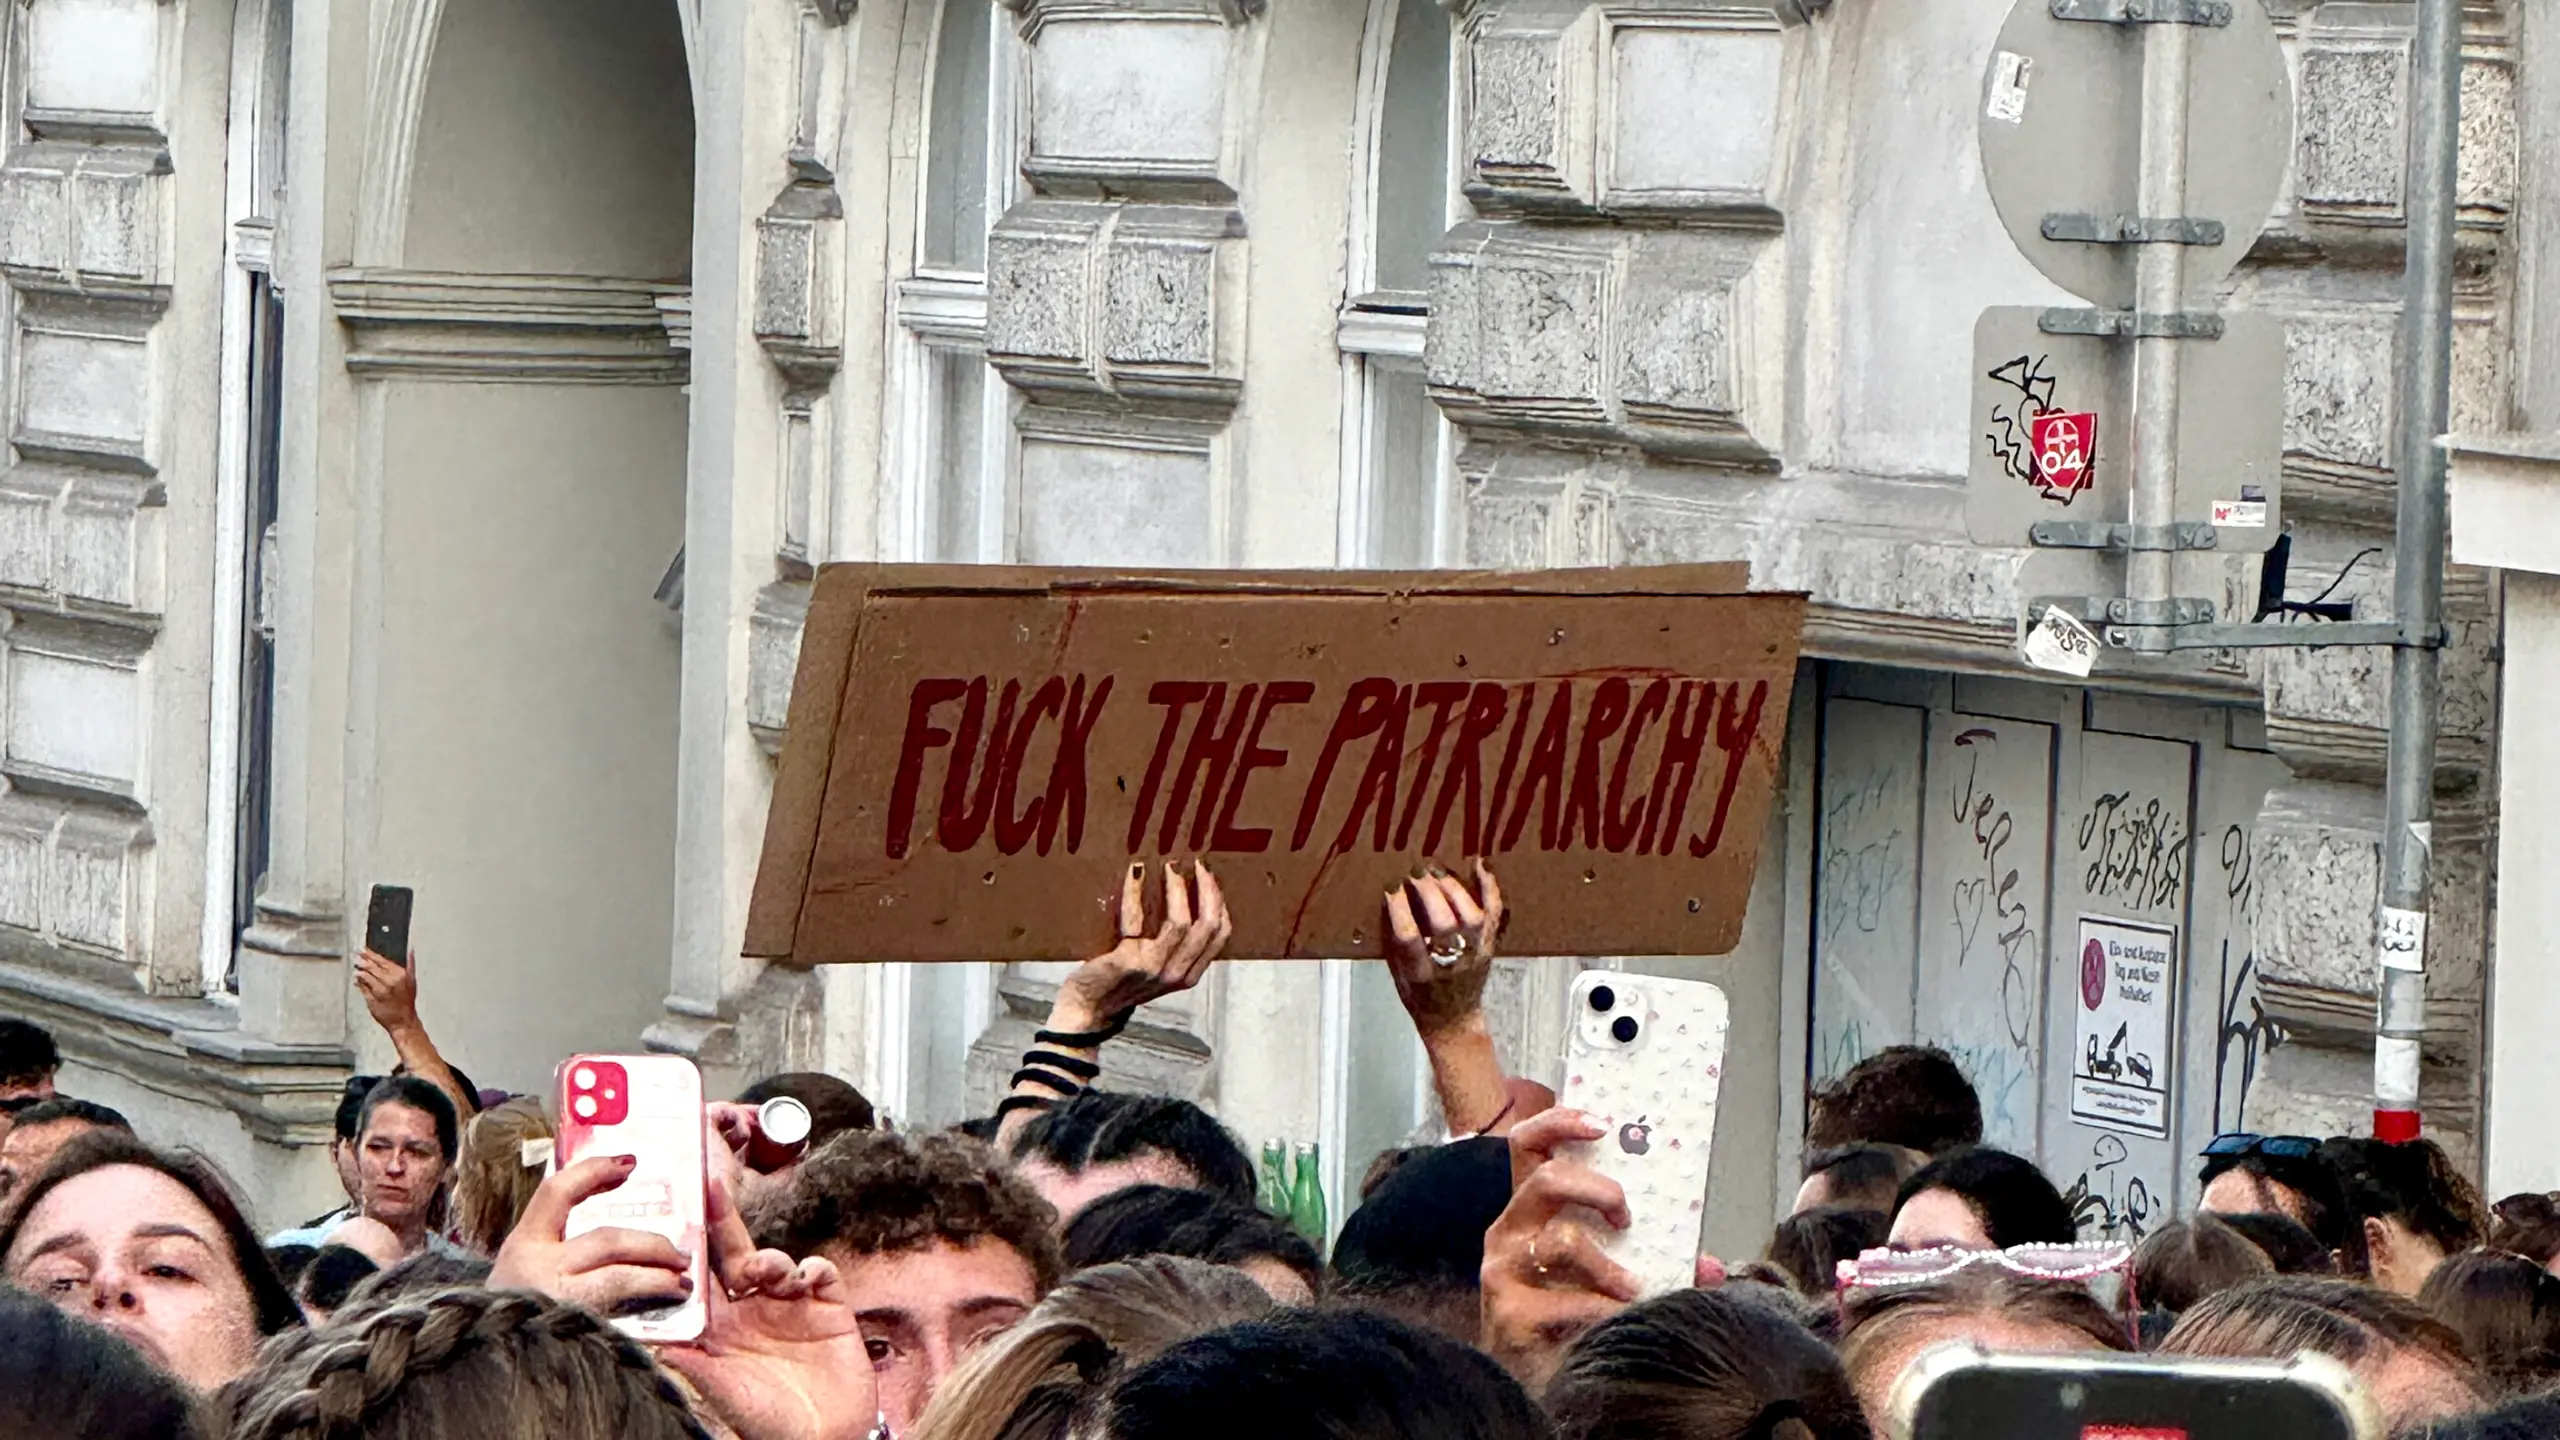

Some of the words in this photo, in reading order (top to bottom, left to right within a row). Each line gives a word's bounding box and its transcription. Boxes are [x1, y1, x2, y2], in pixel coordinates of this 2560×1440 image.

[2041, 449, 2083, 474] 04
[886, 673, 1115, 859] FUCK
[1127, 681, 1316, 855] THE
[1290, 676, 1768, 858] PATRIARCHY
